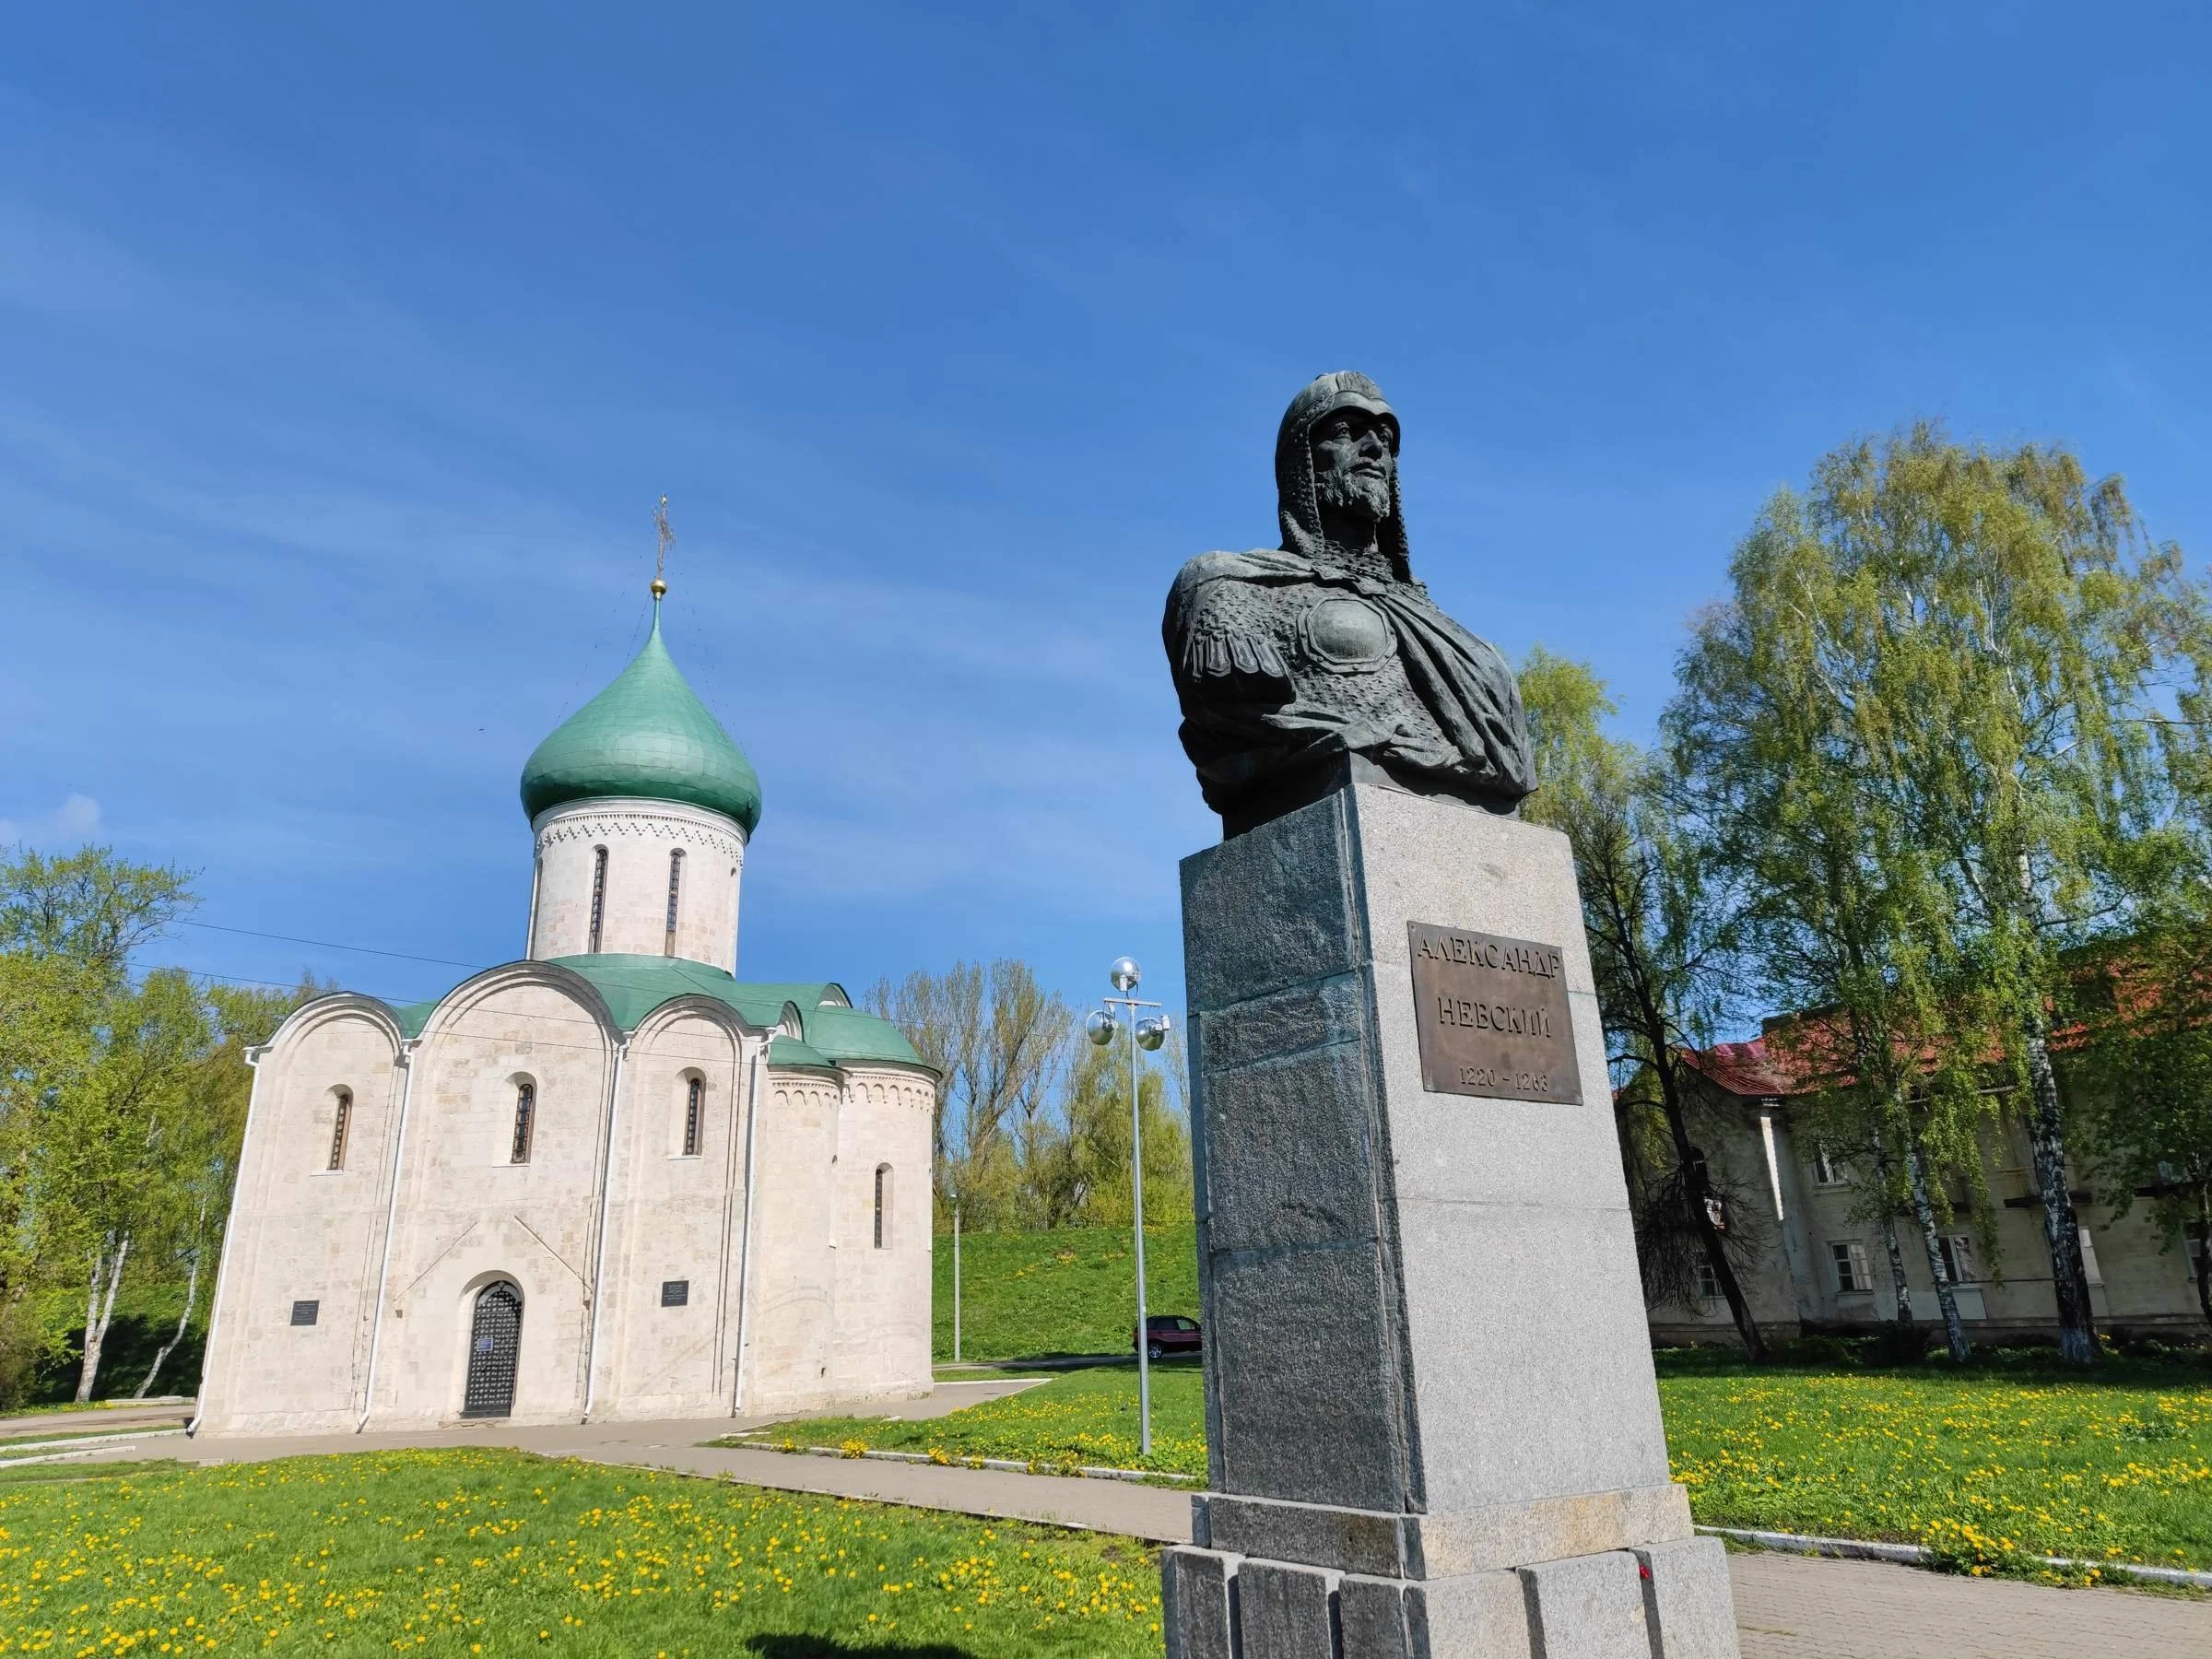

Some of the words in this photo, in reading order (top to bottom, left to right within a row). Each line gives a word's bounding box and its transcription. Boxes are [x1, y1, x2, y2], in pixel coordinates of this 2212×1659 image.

[1418, 932, 1560, 980] АЛЕКСАНДР
[1438, 996, 1551, 1038] НЕВСКИЙ
[1459, 1067, 1496, 1088] 1220
[1515, 1073, 1549, 1092] 1263
